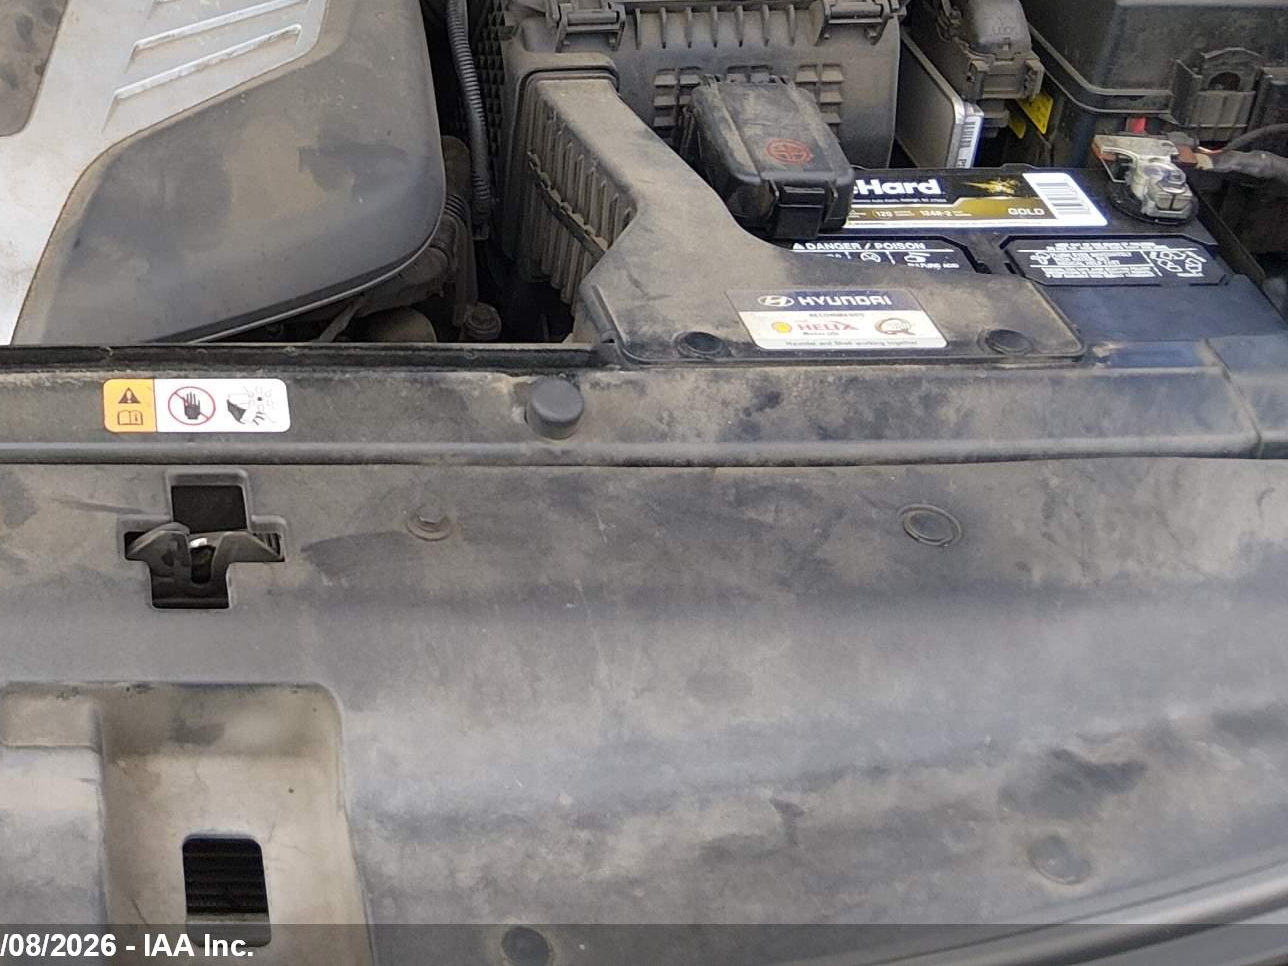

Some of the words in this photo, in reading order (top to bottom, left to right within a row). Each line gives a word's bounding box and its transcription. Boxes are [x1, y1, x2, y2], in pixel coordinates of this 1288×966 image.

[1008, 207, 1045, 216] GOLD
[805, 242, 862, 250] DANGER
[874, 242, 926, 250] POISON
[798, 295, 893, 306] HYUNDAI
